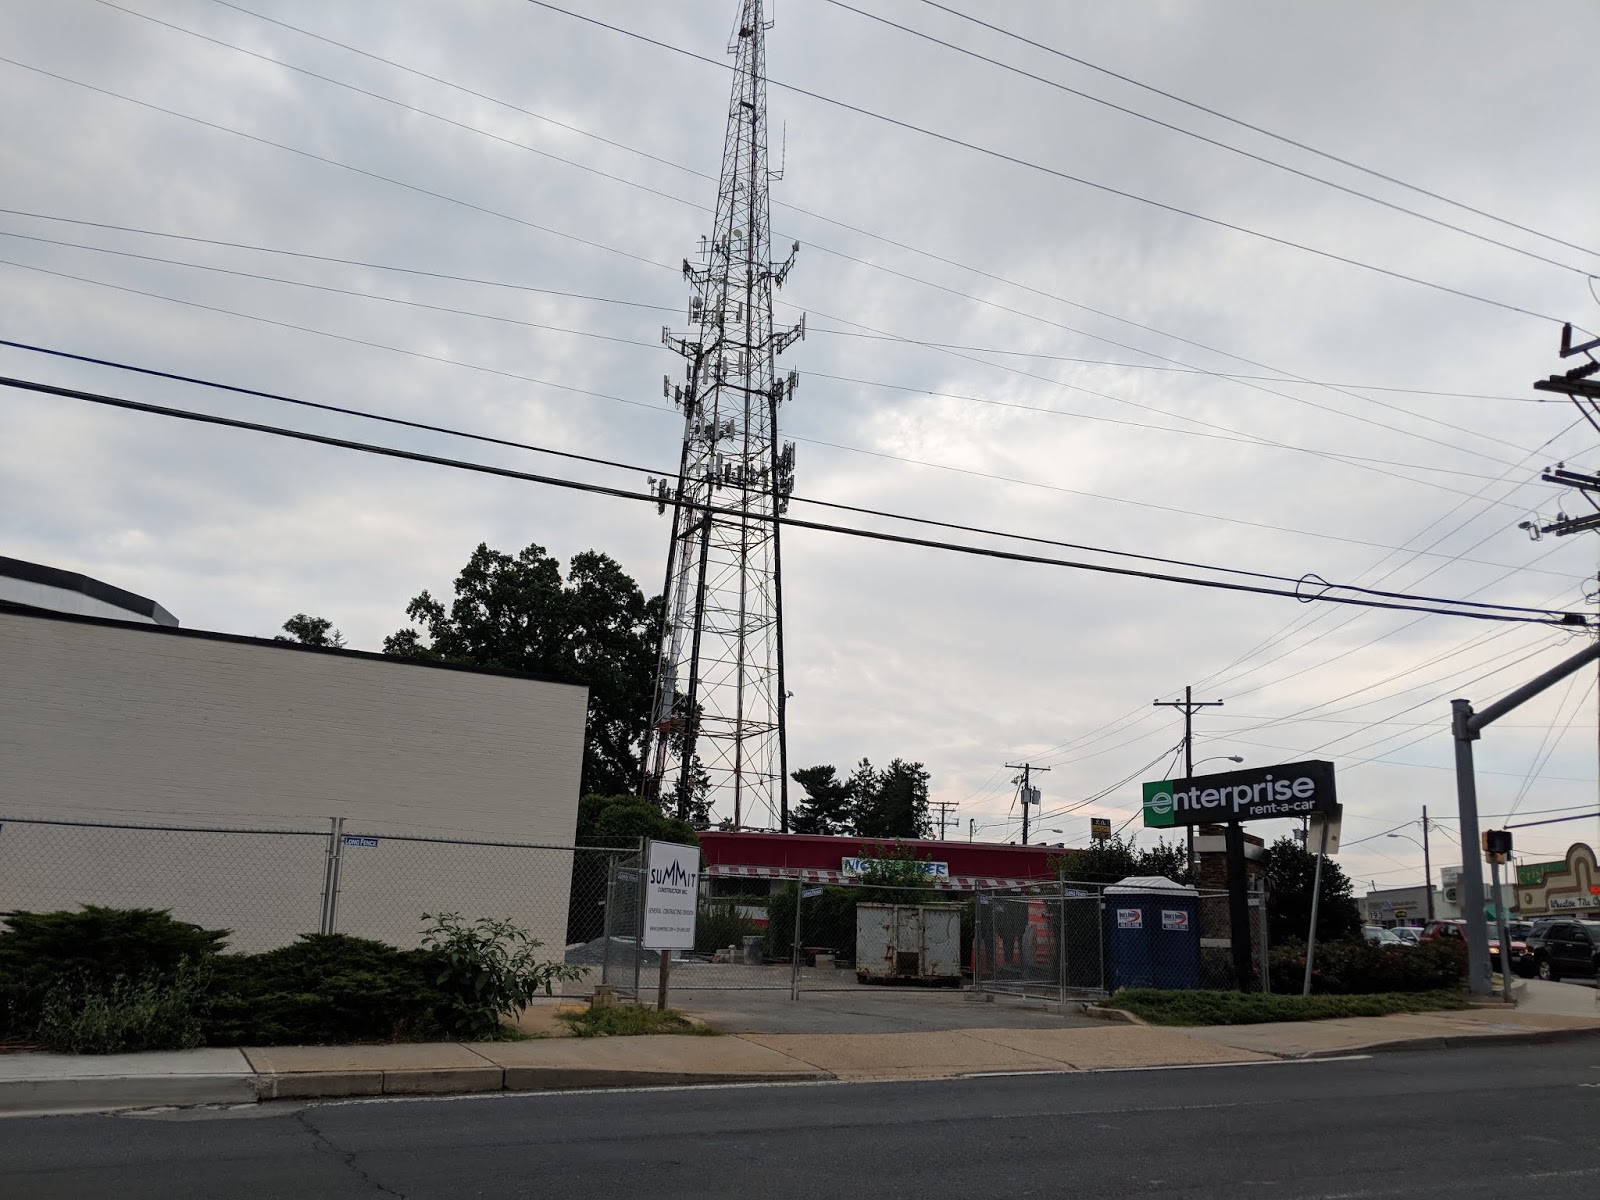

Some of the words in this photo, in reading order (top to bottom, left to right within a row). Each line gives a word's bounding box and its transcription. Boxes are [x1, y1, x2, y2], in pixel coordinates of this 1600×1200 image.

[1143, 774, 1315, 814] enterprise
[1249, 799, 1316, 815] rent-a-car
[650, 858, 696, 888] SUMMIT
